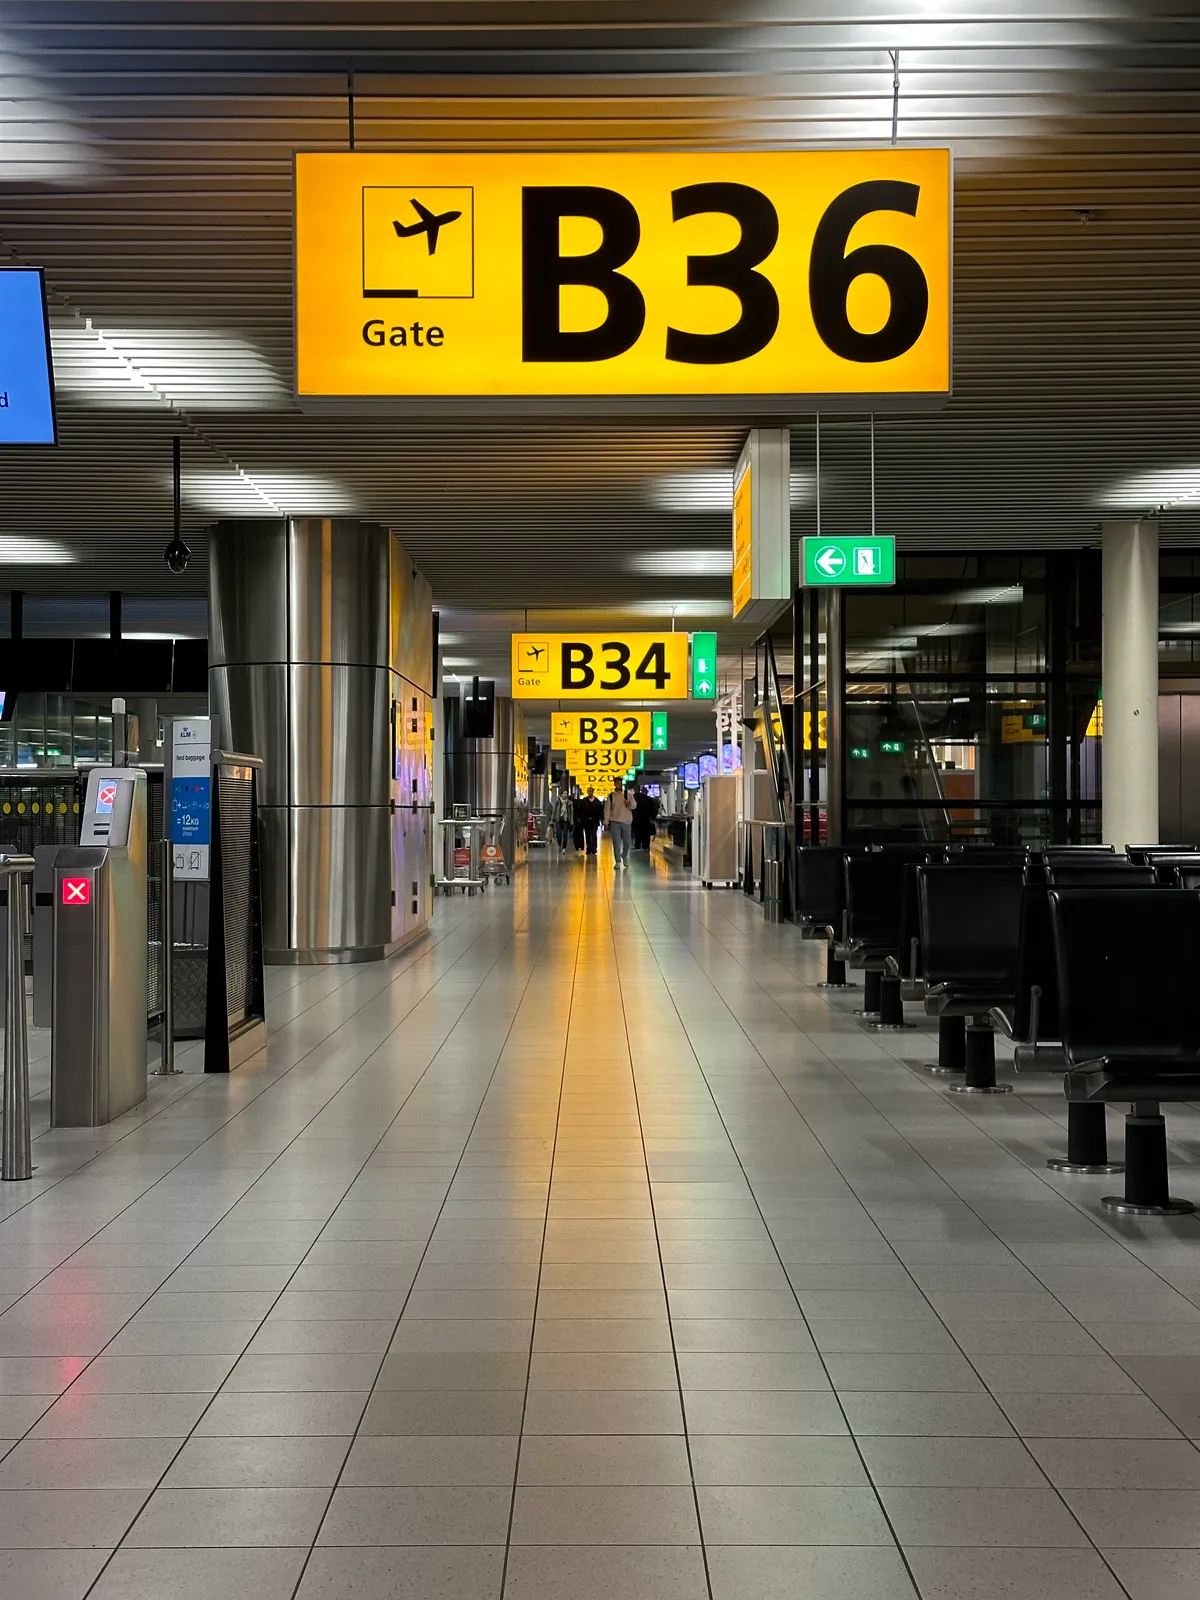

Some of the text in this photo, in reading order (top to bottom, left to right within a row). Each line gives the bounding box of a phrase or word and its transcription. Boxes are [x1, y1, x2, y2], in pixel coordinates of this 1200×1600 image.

[522, 180, 929, 364] B36
[362, 319, 444, 347] Gate
[561, 641, 671, 690] B34
[517, 677, 541, 687] Gate
[579, 717, 640, 744] B32
[585, 749, 627, 766] B30
